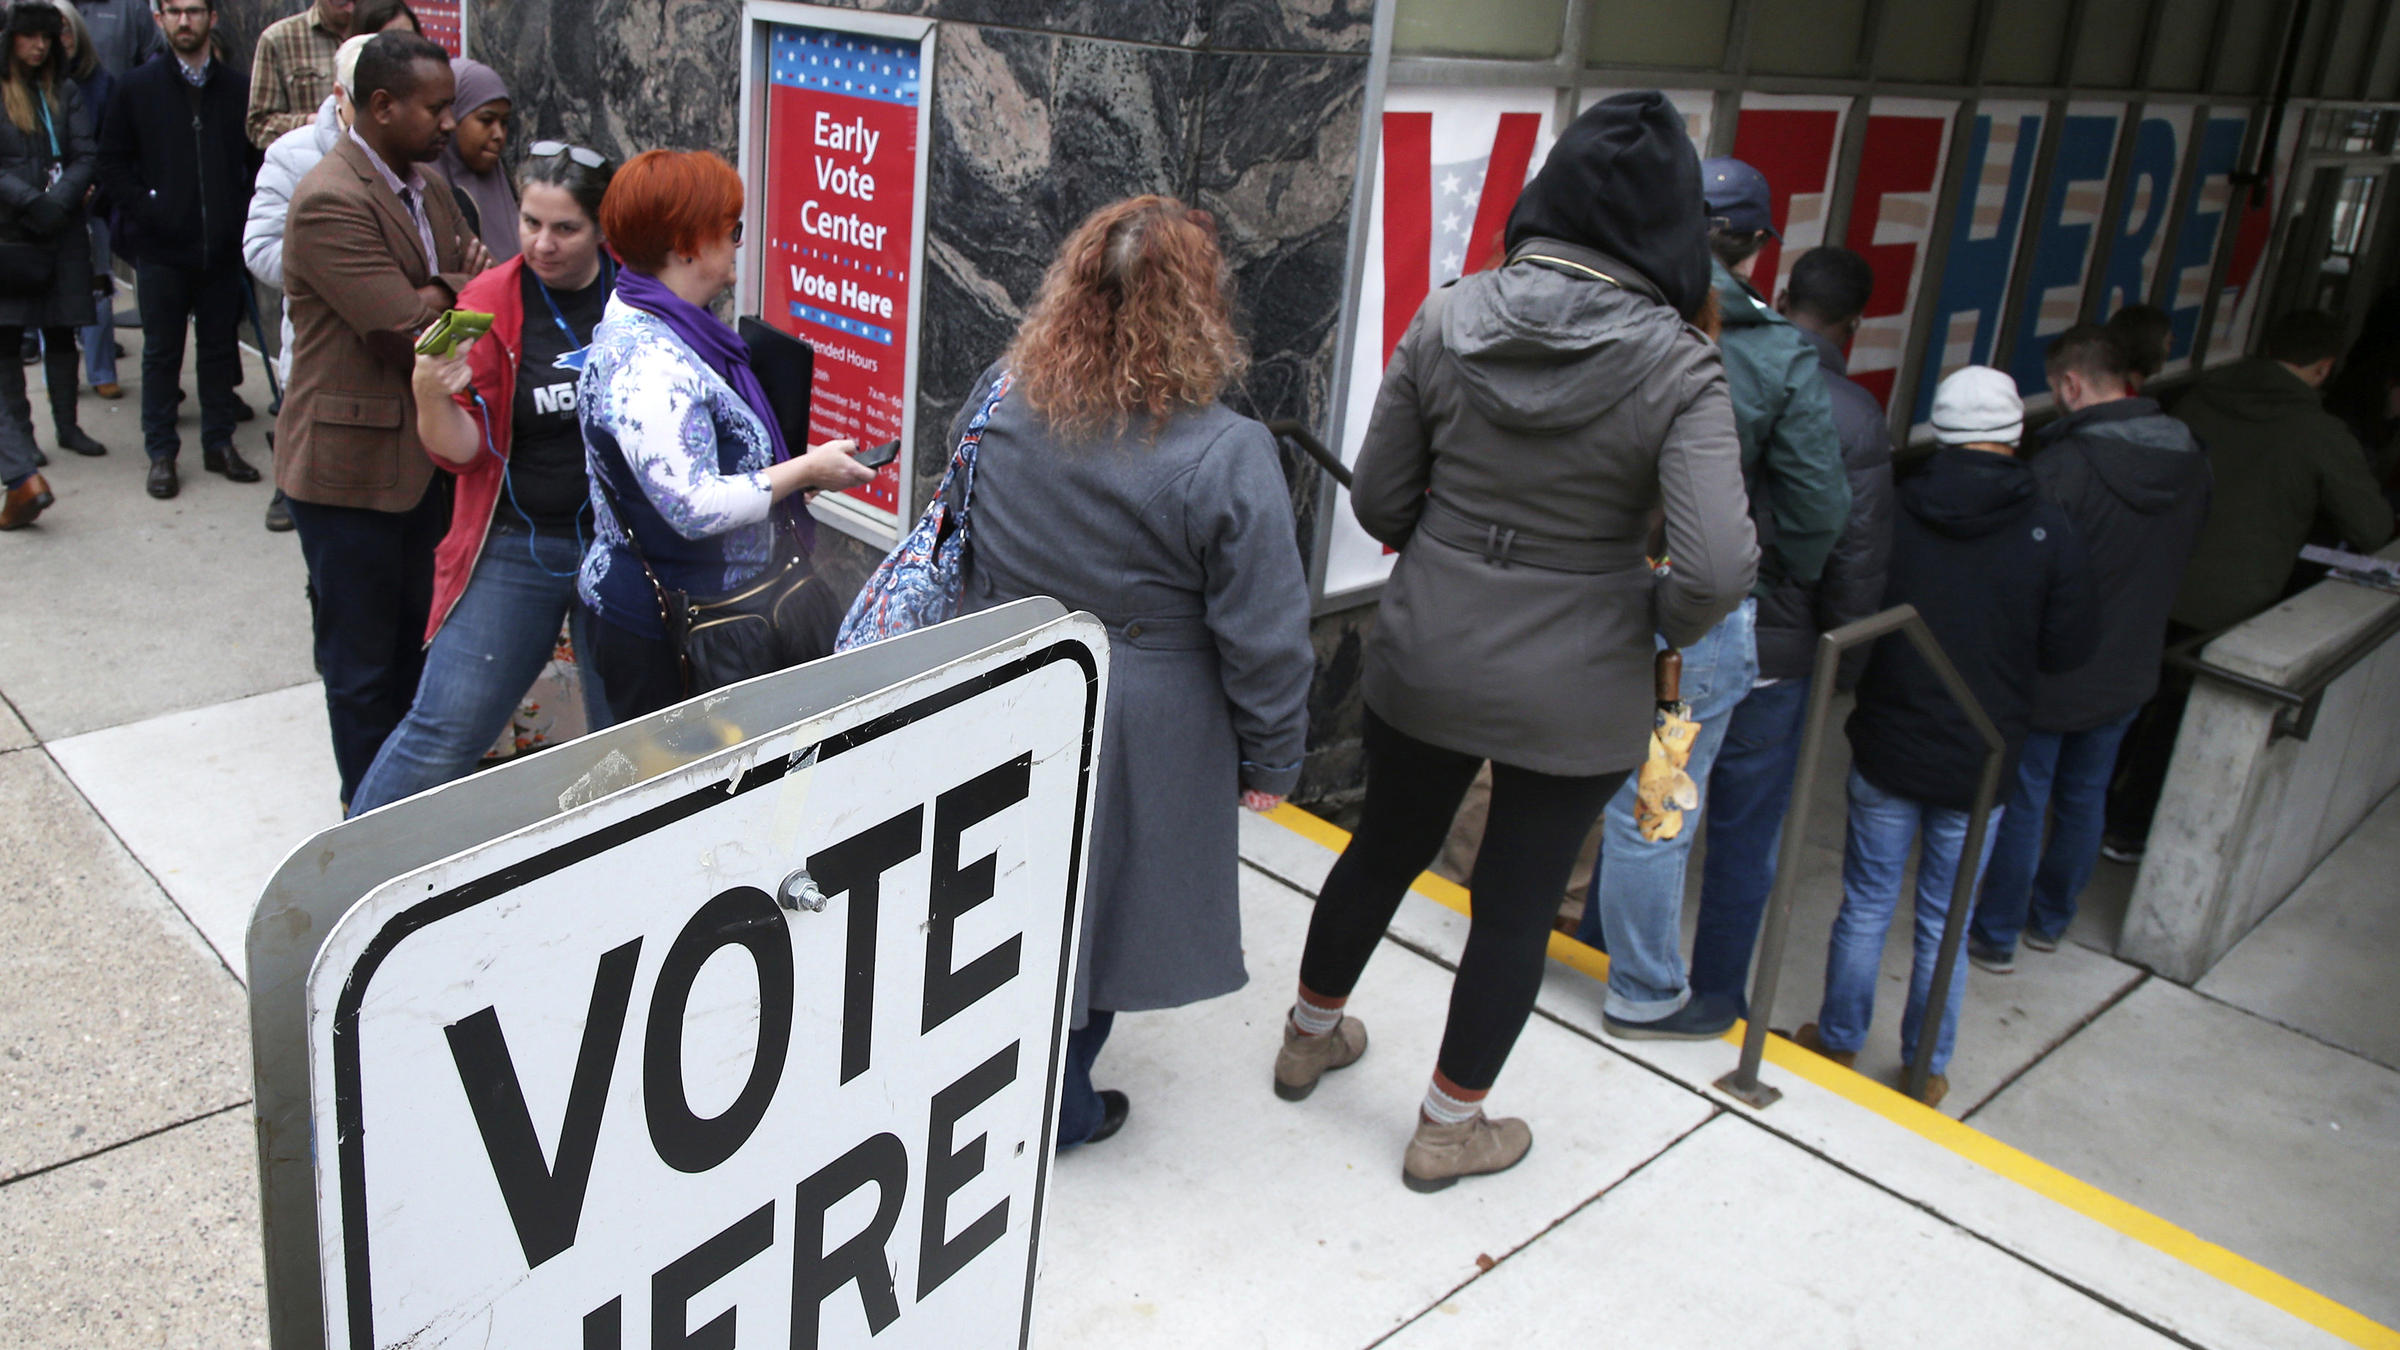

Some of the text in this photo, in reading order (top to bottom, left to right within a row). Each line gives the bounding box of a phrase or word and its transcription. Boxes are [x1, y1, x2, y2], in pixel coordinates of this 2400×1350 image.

[814, 110, 880, 165] Early
[814, 154, 875, 201] Vote
[801, 199, 887, 251] Center
[790, 264, 893, 319] Vote Here
[1909, 114, 2247, 428] HERE
[799, 332, 878, 372] Etended Hours
[813, 385, 848, 407] November
[813, 403, 848, 424] November
[443, 749, 1033, 1270] VOTE
